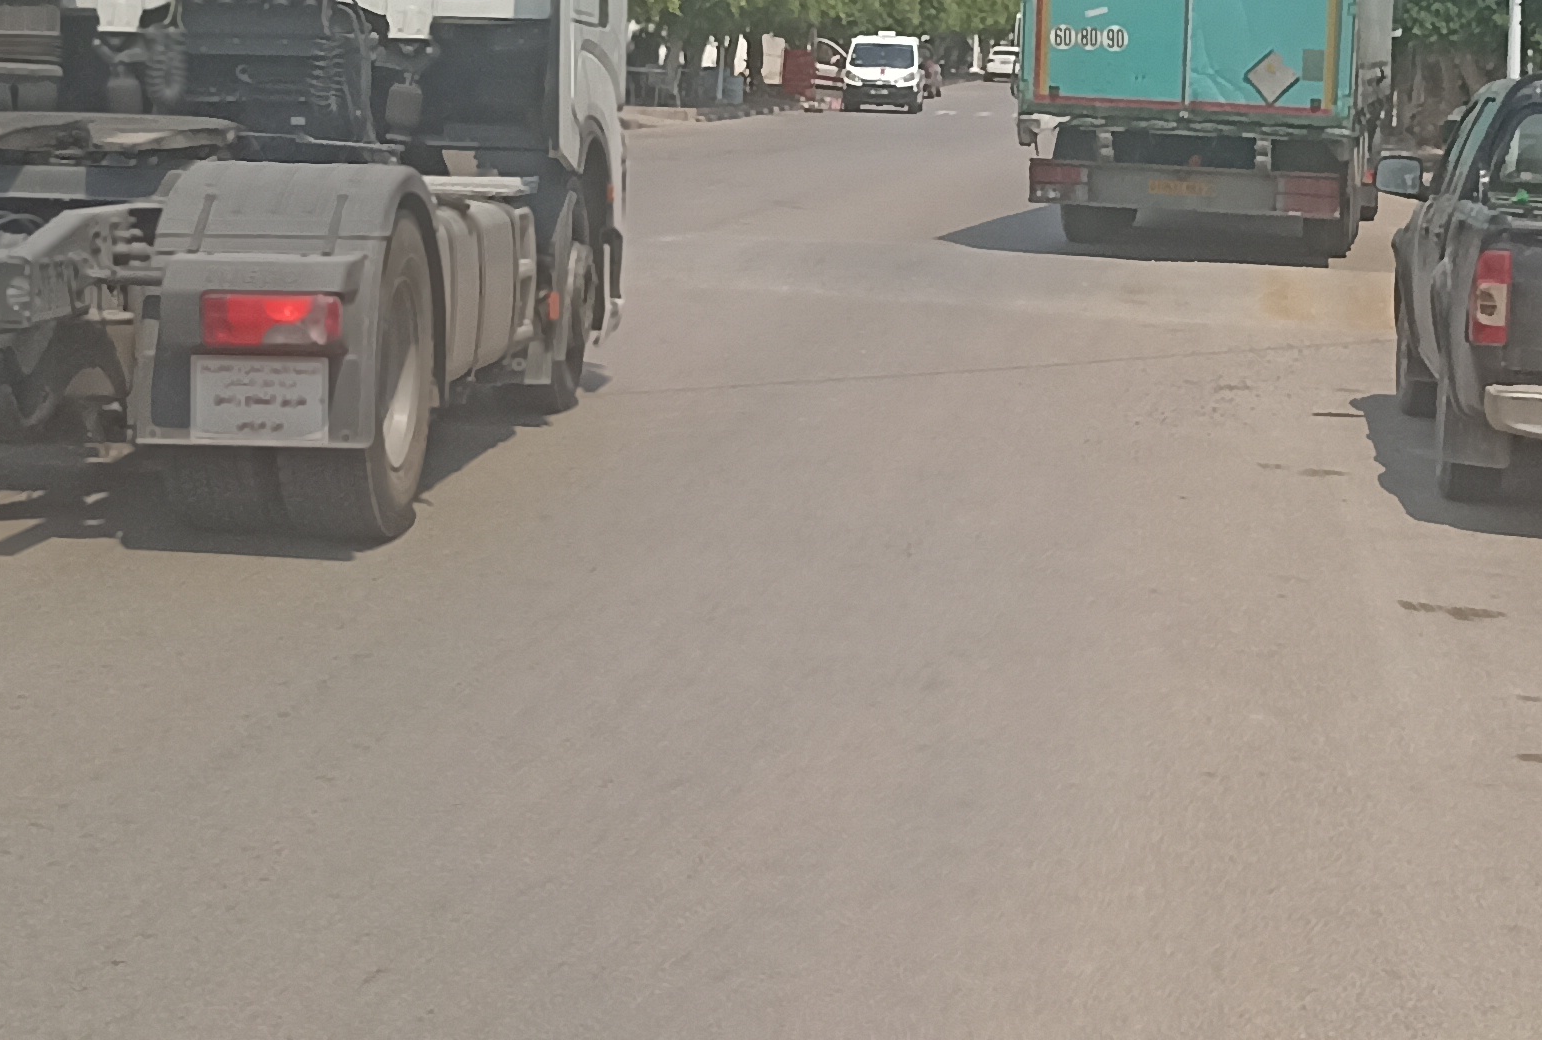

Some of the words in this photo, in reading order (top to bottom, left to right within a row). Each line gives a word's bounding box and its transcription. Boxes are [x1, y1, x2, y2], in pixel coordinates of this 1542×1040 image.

[1054, 27, 1072, 46] 60
[1081, 28, 1098, 47] 80
[1107, 28, 1125, 48] 90
